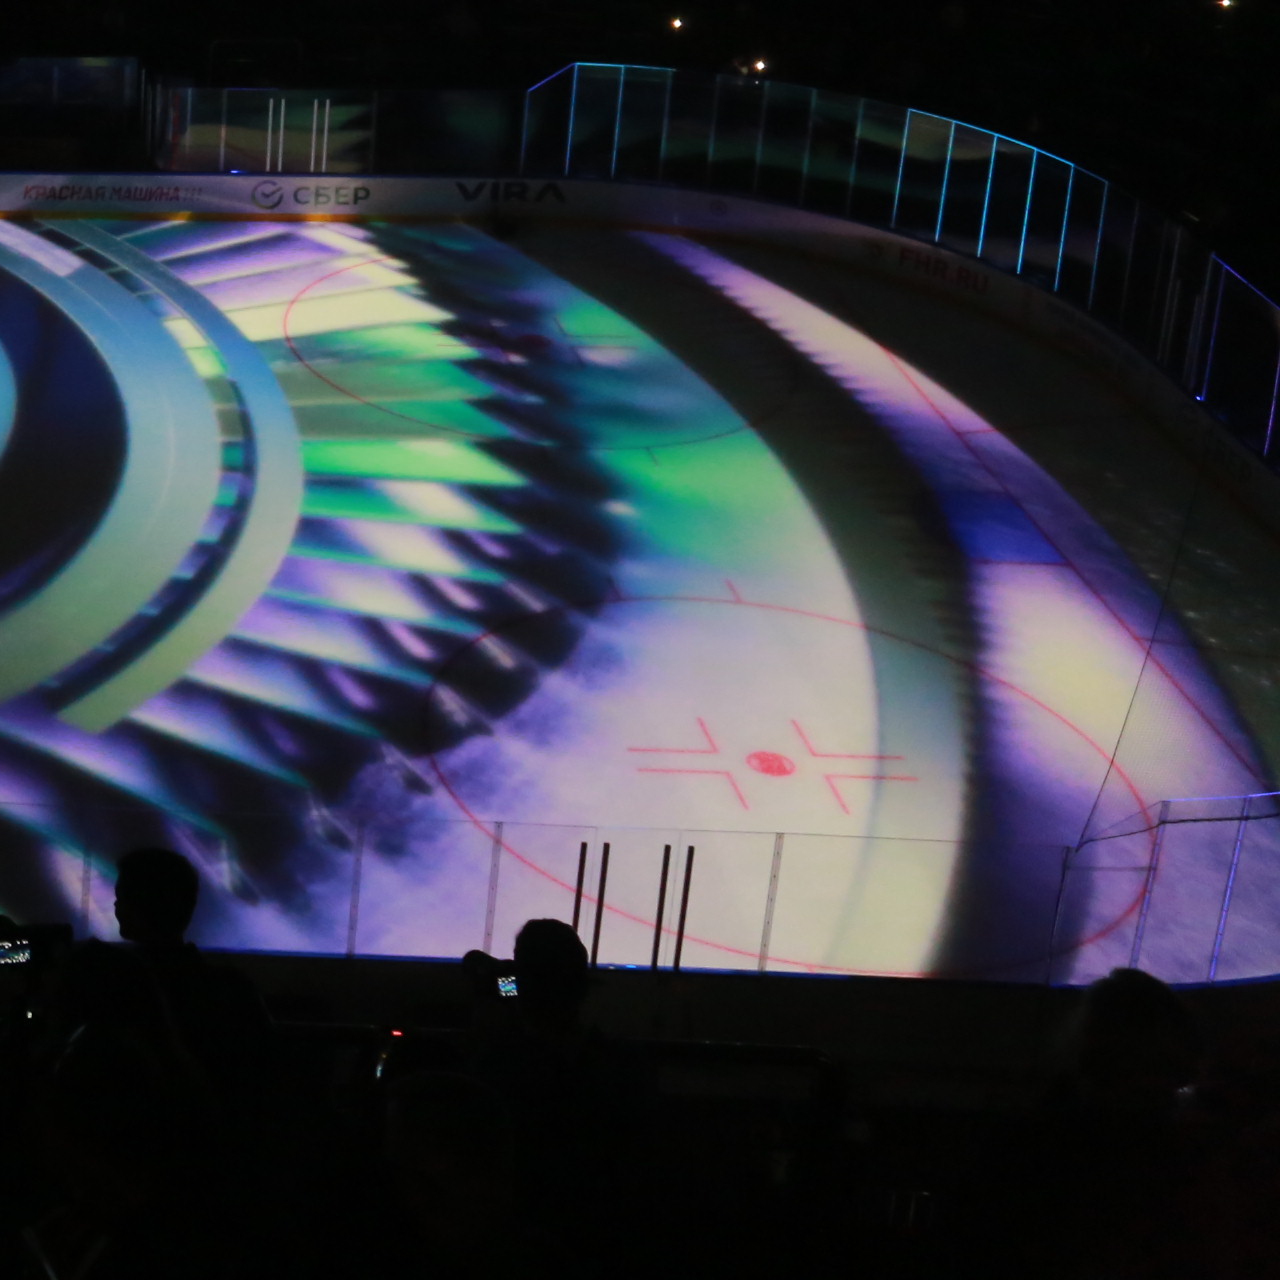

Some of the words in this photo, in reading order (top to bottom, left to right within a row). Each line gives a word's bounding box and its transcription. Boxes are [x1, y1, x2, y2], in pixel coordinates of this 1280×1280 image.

[22, 184, 107, 201] КРАСНАЯ
[292, 185, 371, 207] СБЕР
[455, 180, 567, 204] VIRA
[897, 247, 990, 294] FHR.RU
